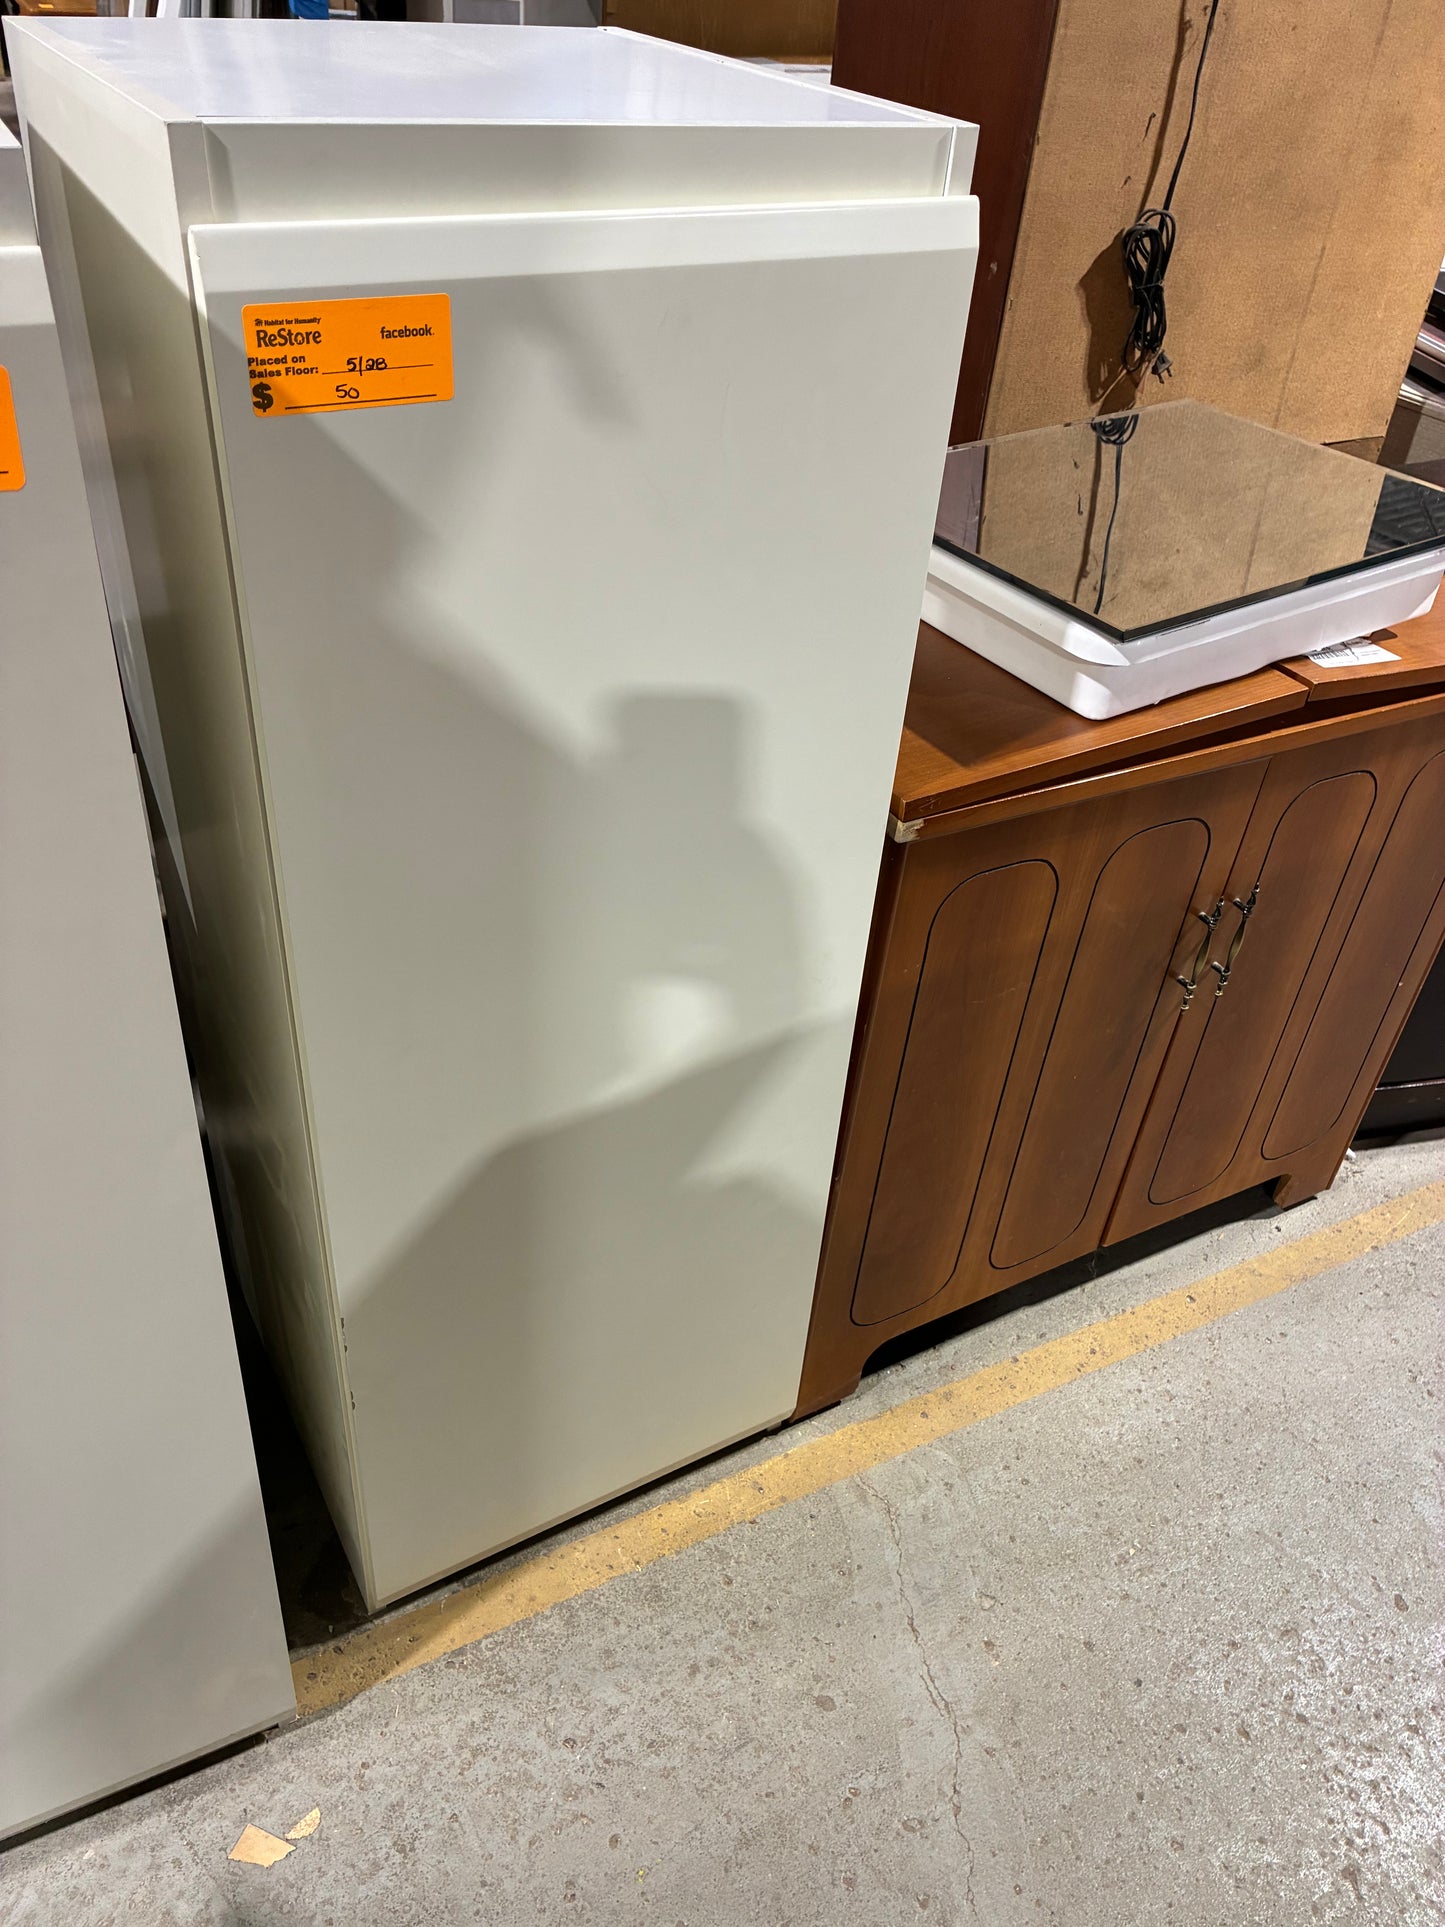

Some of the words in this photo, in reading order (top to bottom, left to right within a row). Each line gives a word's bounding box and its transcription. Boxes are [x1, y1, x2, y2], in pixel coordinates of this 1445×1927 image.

[294, 317, 322, 326] Humanity
[256, 327, 322, 348] ReStore
[247, 356, 288, 367] Placed
[291, 355, 306, 363] on
[249, 367, 282, 379] Sales
[285, 366, 319, 376] Floor:
[252, 381, 274, 413] $
[335, 383, 360, 399] 50
